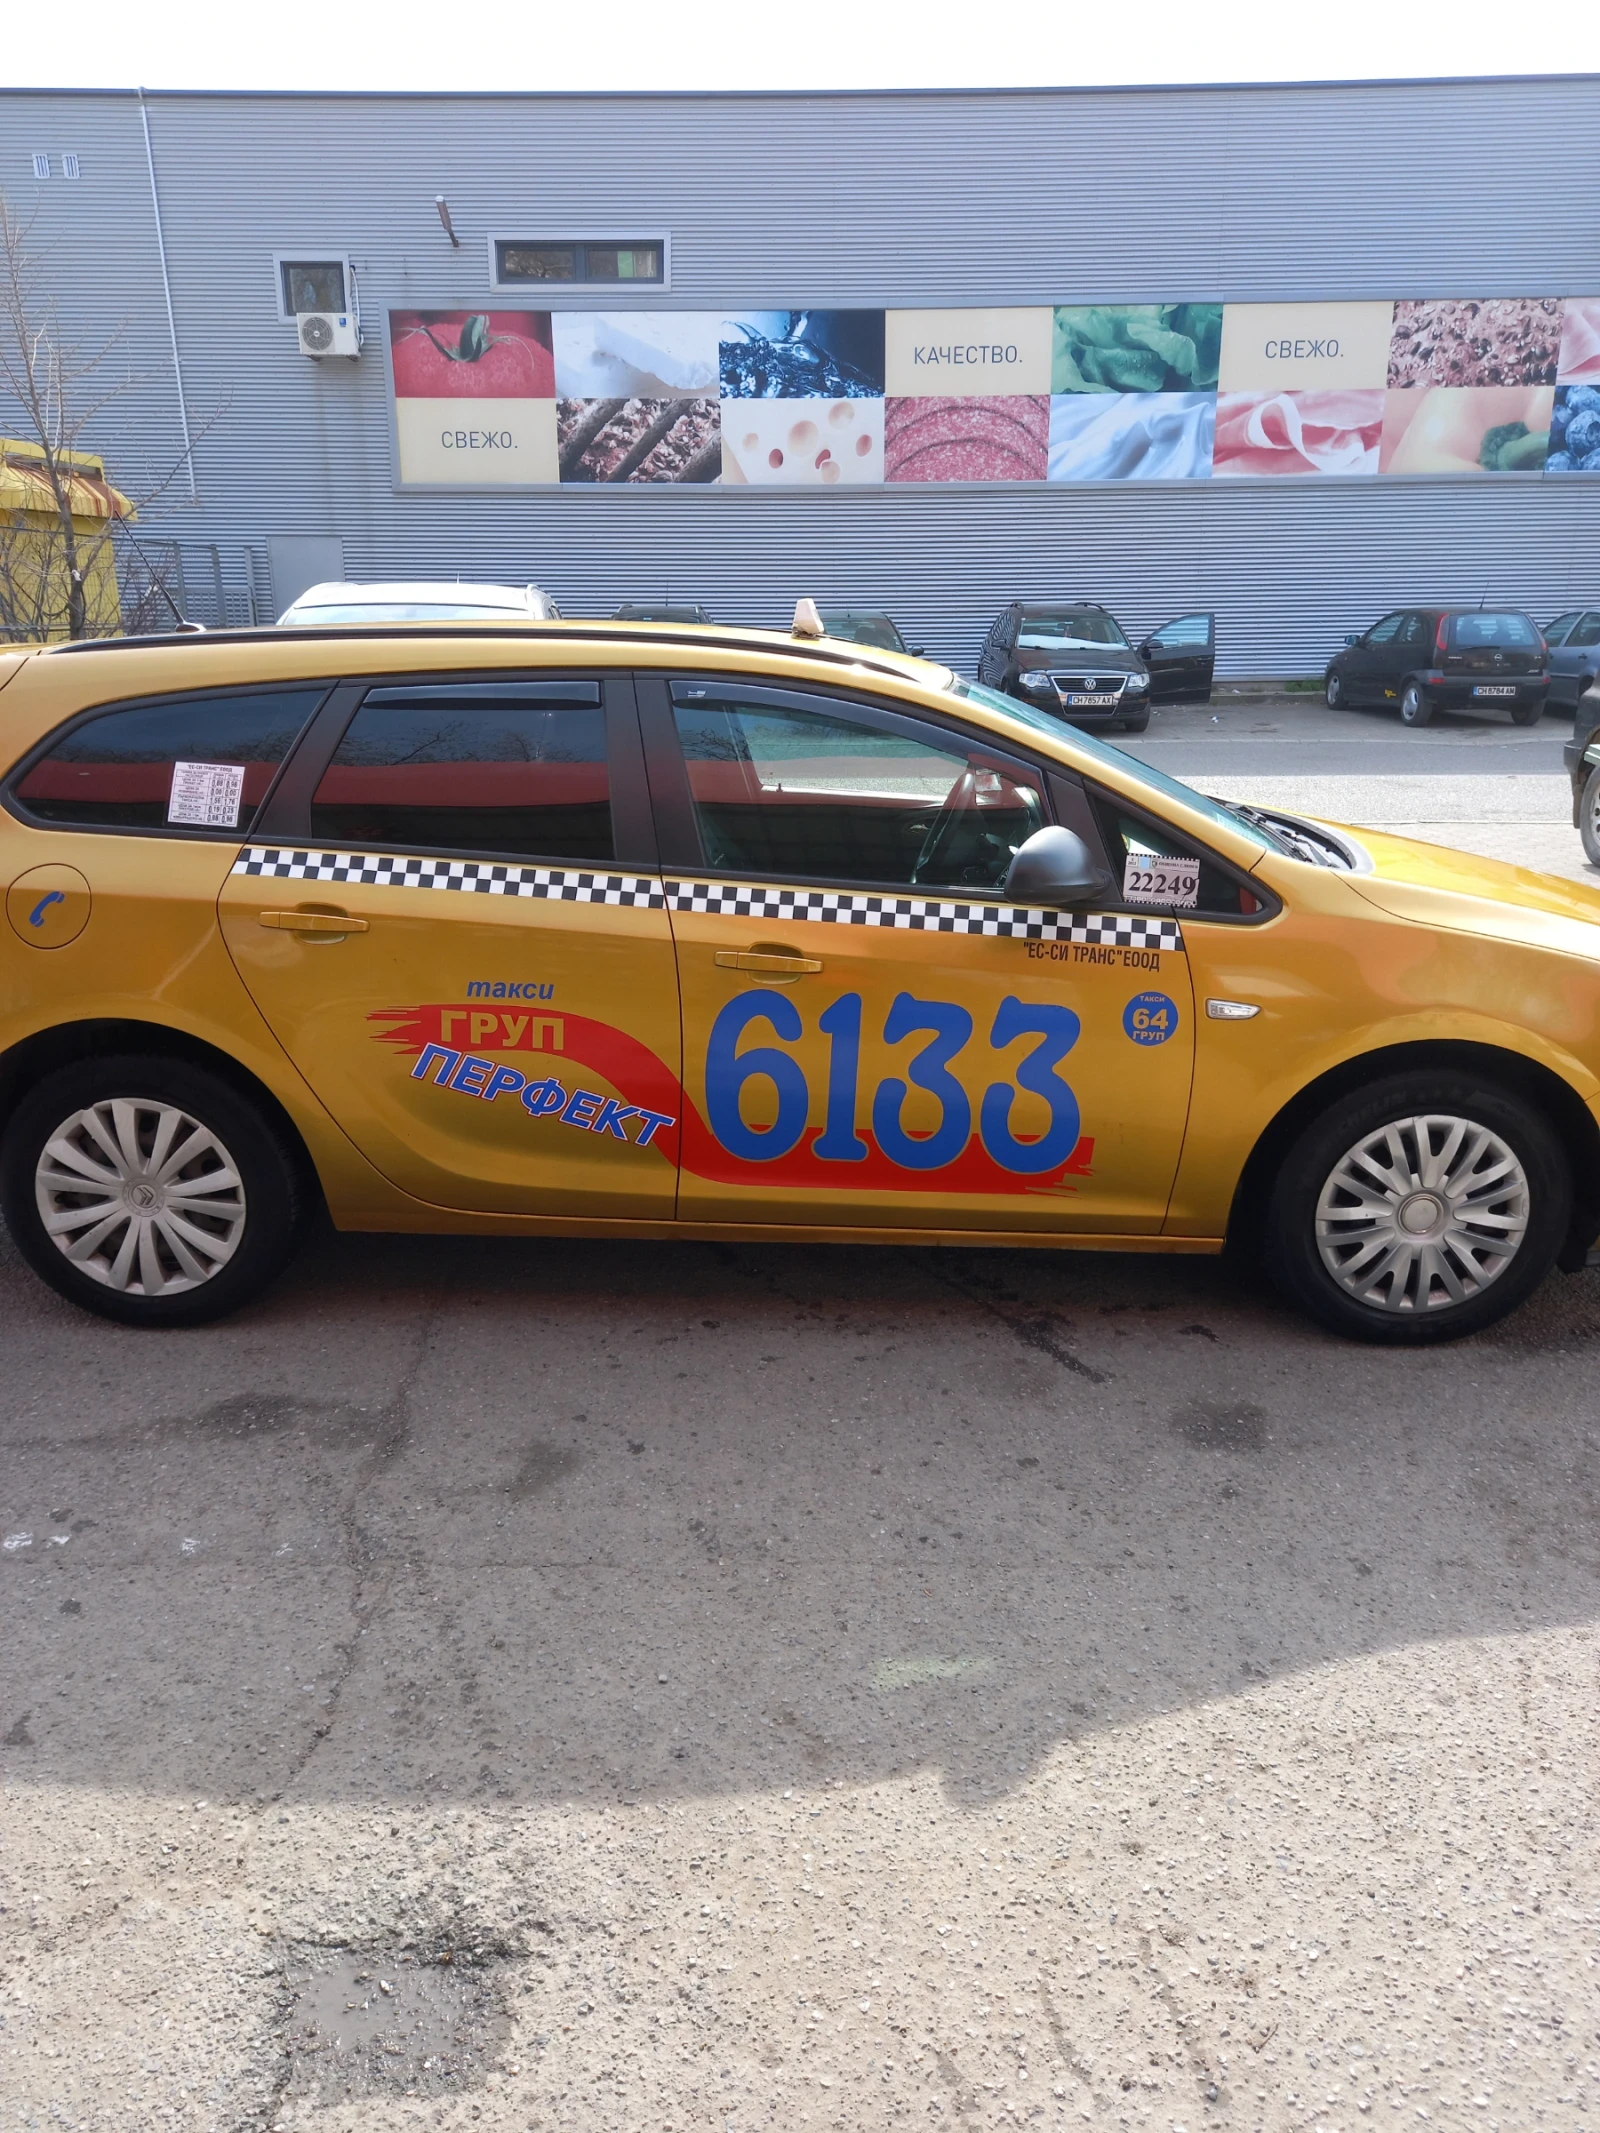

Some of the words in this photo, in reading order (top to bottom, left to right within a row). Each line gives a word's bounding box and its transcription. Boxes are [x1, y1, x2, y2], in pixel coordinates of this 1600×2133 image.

[914, 345, 1022, 365] КАЧЕСТВО.
[1265, 339, 1343, 359] СВЕЖО.
[441, 430, 518, 449] СВЕЖО.
[1073, 696, 1083, 704] CH
[1102, 696, 1111, 704] AX
[1478, 687, 1487, 695] CH
[1128, 871, 1196, 896] 22249
[1023, 941, 1068, 961] "ЕС-СИ
[466, 979, 555, 1000] такси
[1139, 995, 1165, 1003] ТАКСИ
[1132, 1008, 1168, 1030] 64
[440, 1009, 565, 1051] ГРУП
[1132, 1031, 1165, 1041] ГРУП
[705, 988, 1081, 1175] 6133
[409, 1041, 676, 1148] ПЕРФЕКТ
